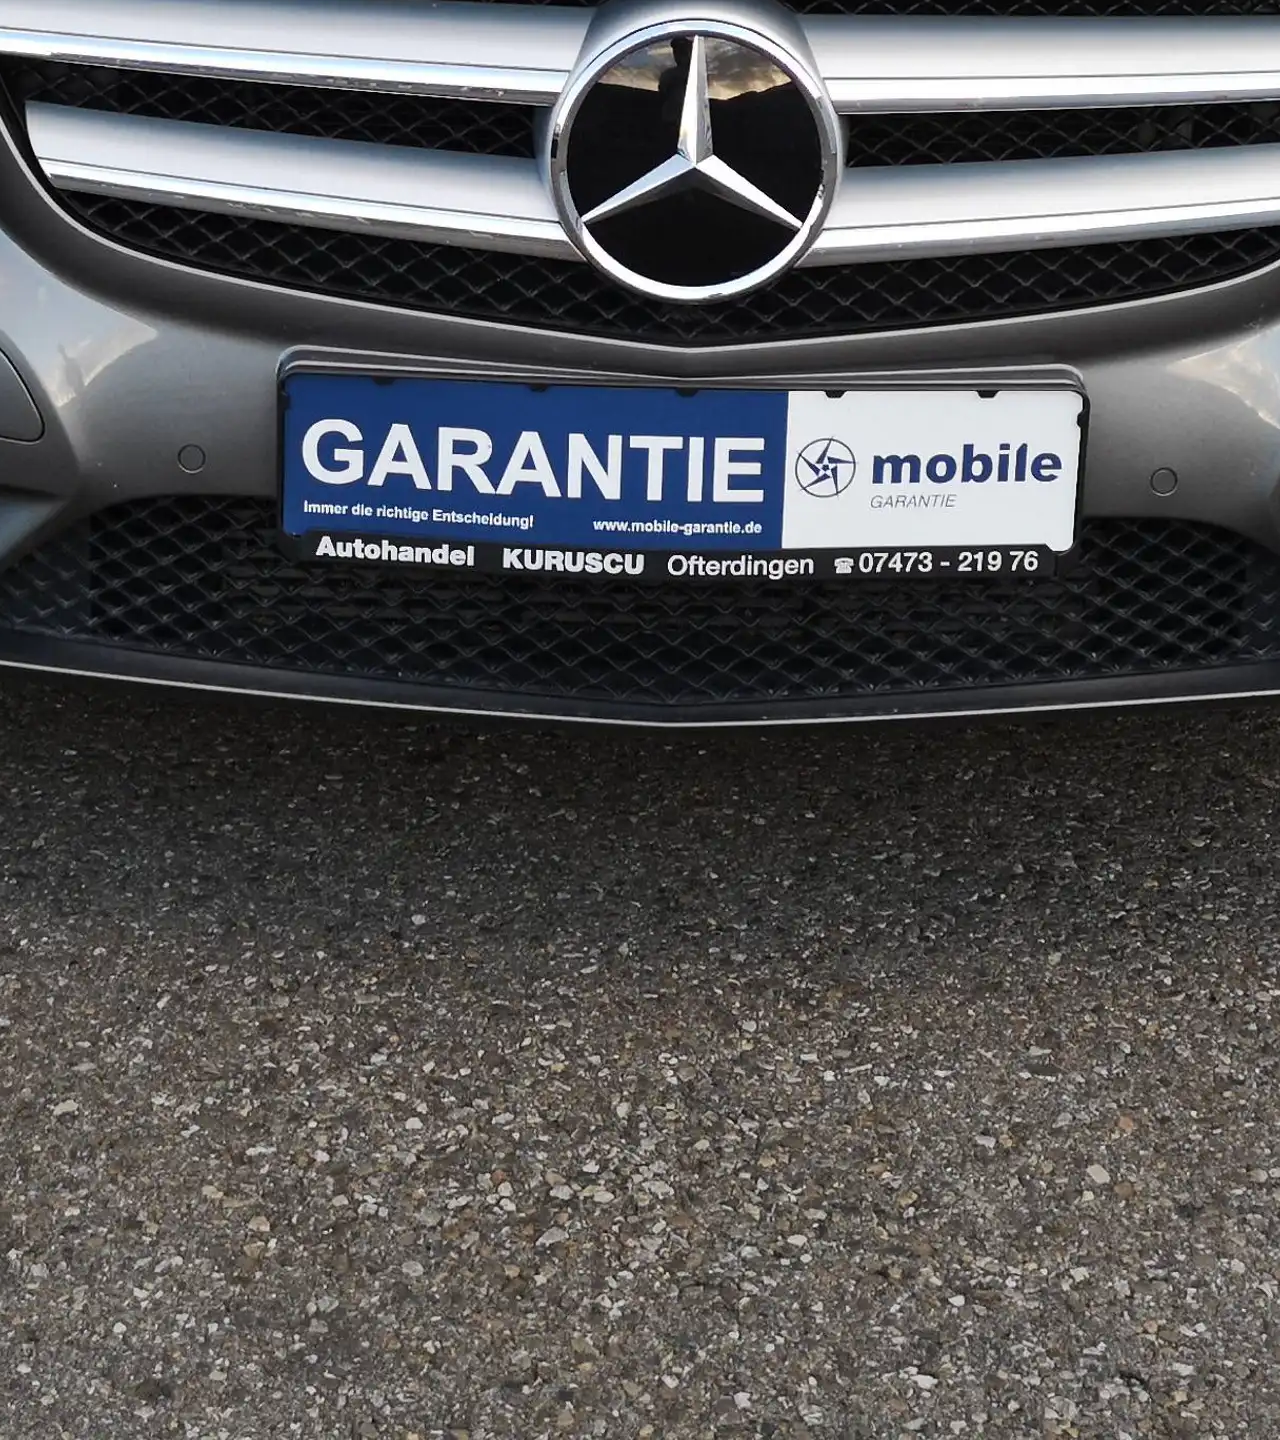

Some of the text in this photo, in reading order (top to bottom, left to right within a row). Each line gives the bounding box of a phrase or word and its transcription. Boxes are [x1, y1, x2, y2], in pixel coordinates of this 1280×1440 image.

[302, 418, 765, 502] GARANTIE
[872, 443, 1062, 484] mobile
[304, 500, 534, 530] Immer die richtige Entscheidung!
[870, 494, 957, 509] GARANTIE
[593, 519, 762, 536] www.mobile-garantie.de
[316, 535, 475, 566] Autohandel
[502, 547, 644, 575] KURUSCU
[667, 554, 814, 581] Ofterdingen
[859, 551, 933, 574] 07473
[957, 550, 1001, 573] 219
[1009, 550, 1039, 572] 76
